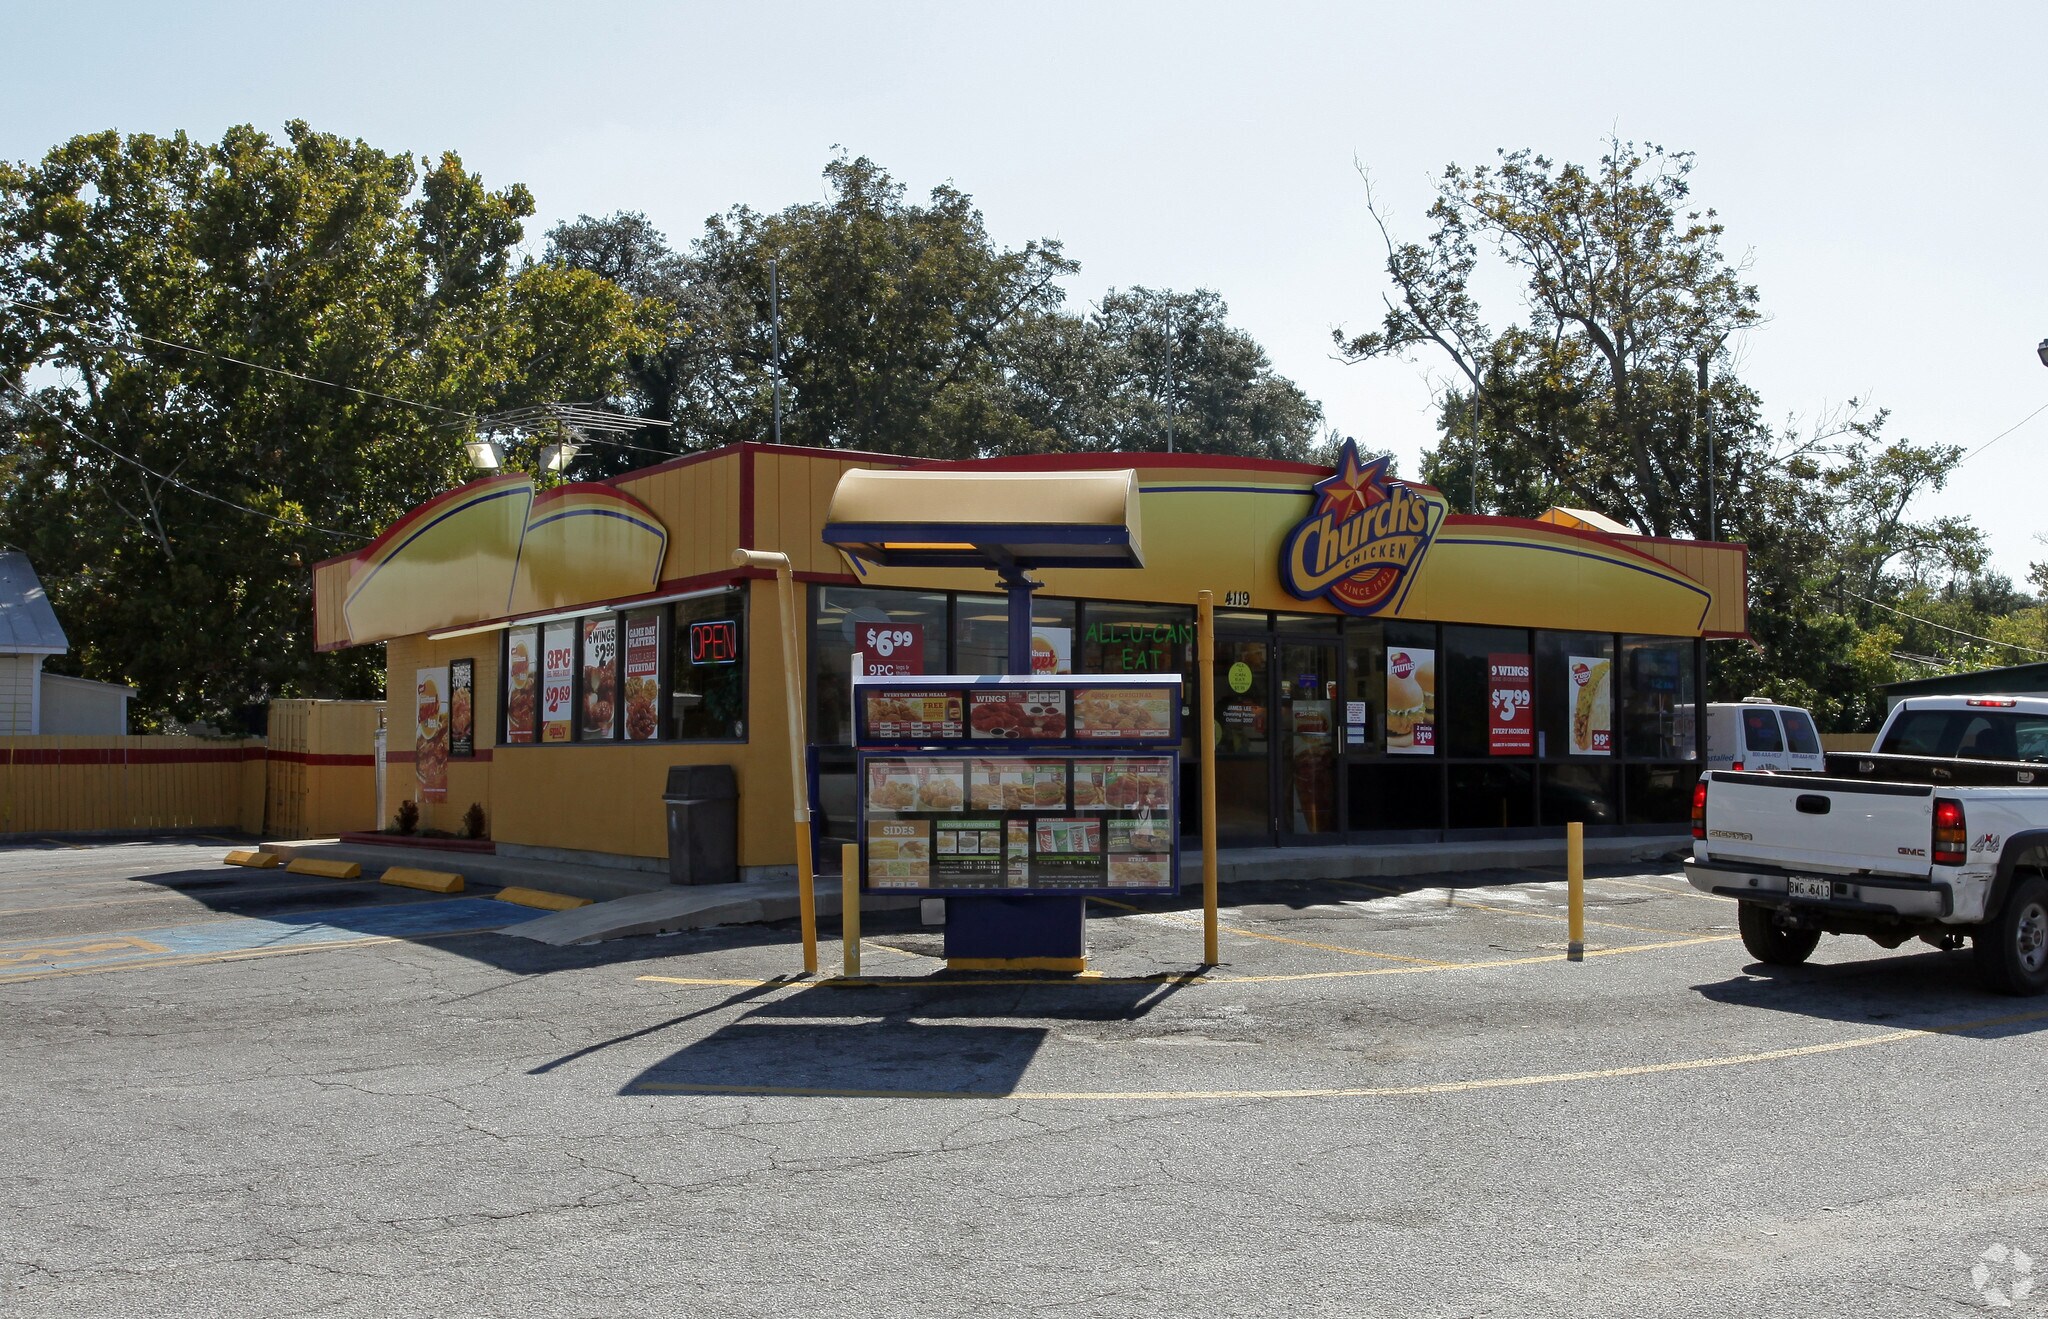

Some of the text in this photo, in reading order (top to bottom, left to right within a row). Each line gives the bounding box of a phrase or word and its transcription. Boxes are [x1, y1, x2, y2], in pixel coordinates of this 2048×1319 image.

[1291, 486, 1427, 592] Church's
[1344, 543, 1406, 569] CHICKEN
[1343, 571, 1390, 596] SINCE 1952
[1225, 591, 1250, 606] 4119
[593, 629, 615, 643] WINGS
[629, 626, 656, 638] GAME DAY
[1086, 623, 1193, 644] ALL-U-CAN
[629, 636, 656, 648] PLATTERS
[692, 625, 735, 660] OPEN
[547, 648, 571, 670] 3PC
[1121, 648, 1162, 670] EAT
[628, 662, 656, 673] EVERYDAY
[869, 664, 894, 676] 9PC
[1391, 661, 1415, 674] minis
[1491, 665, 1529, 677] 9 WINGS
[976, 695, 1007, 703] WINGS
[1593, 733, 1609, 745] 99¢
[1705, 753, 1734, 762] stalled
[883, 826, 915, 835] SIDES
[1897, 847, 1925, 857] GMC
[1789, 881, 1830, 897] BWG 6413
